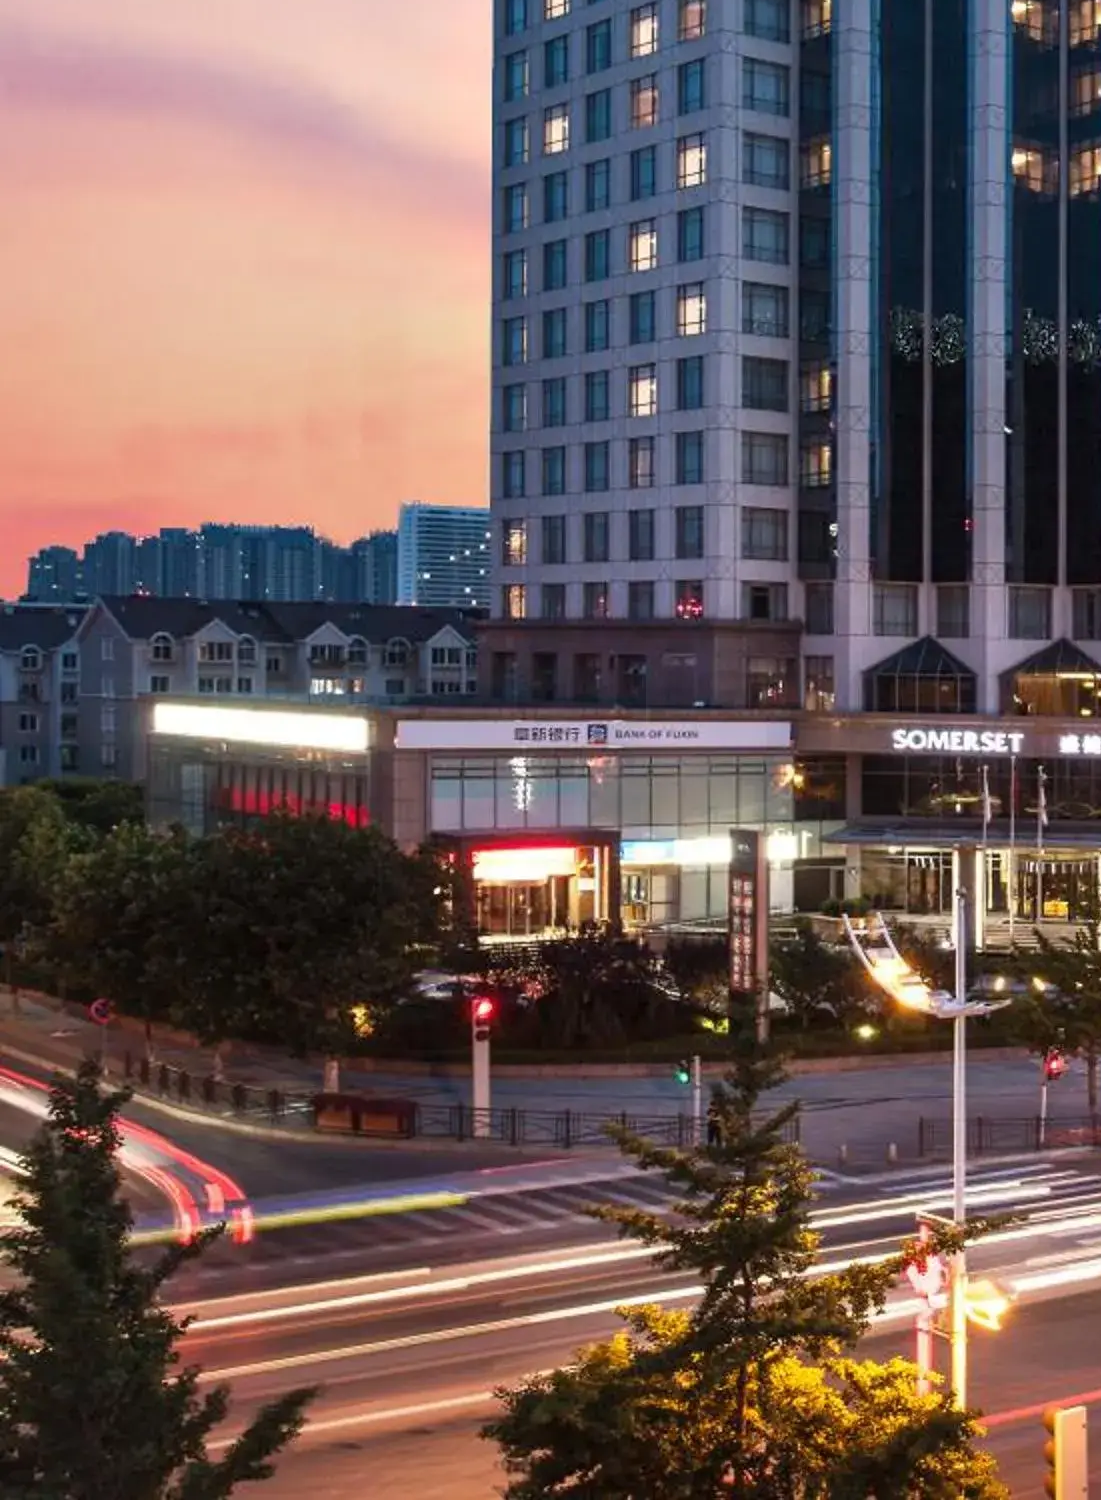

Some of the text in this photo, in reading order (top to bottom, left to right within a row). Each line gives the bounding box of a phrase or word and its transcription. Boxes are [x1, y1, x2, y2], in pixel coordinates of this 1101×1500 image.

[615, 729, 646, 739] BANK
[648, 729, 663, 739] OF
[892, 729, 1025, 753] SOMERSET
